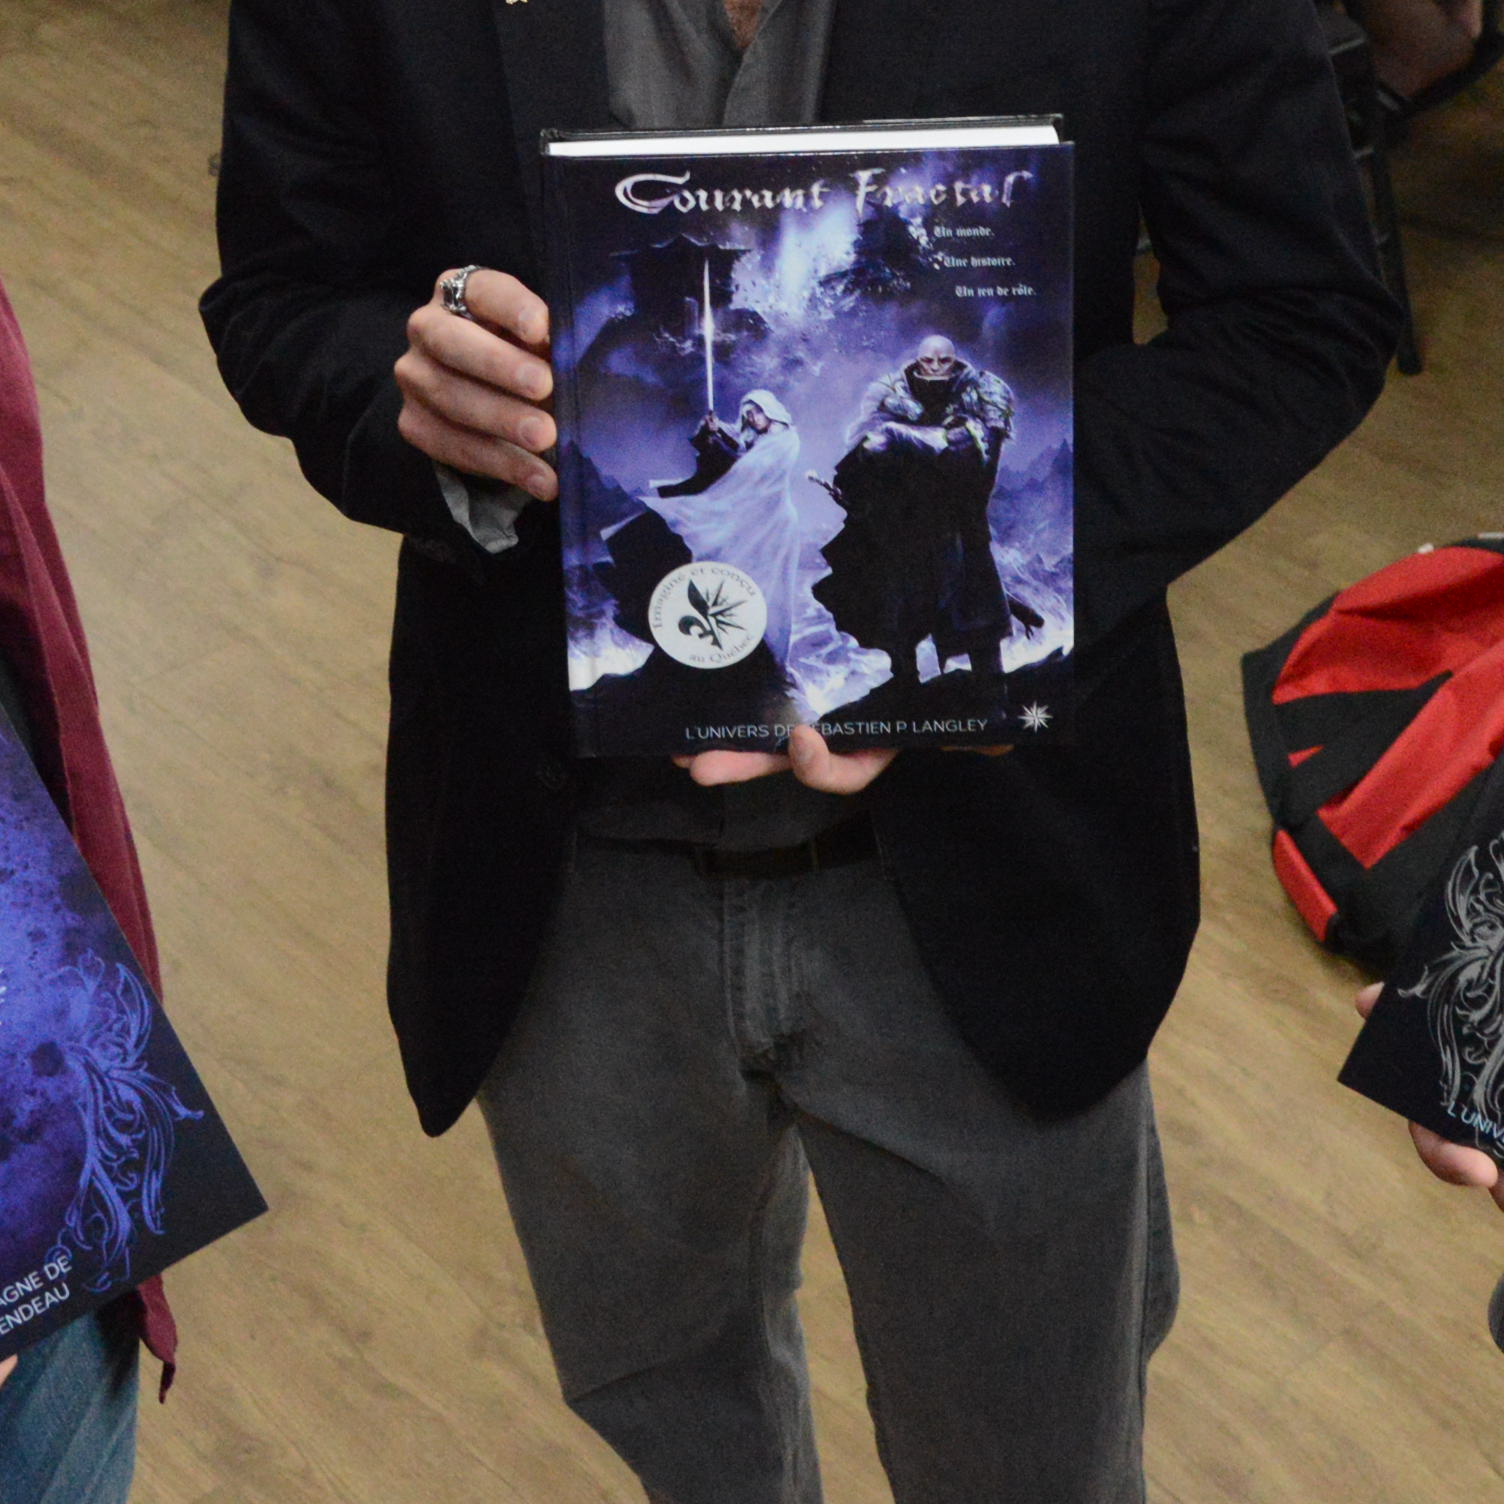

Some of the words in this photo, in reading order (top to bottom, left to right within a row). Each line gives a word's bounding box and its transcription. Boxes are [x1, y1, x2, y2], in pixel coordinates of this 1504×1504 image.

[614, 169, 833, 215] Courant
[848, 168, 1033, 219] Fractal
[932, 225, 953, 238] Un
[955, 226, 996, 238] monde.
[943, 255, 968, 268] Une
[970, 255, 1016, 269] histoire.
[955, 285, 975, 297] Un
[912, 718, 989, 734] LANGLEY
[43, 1253, 74, 1282] DE
